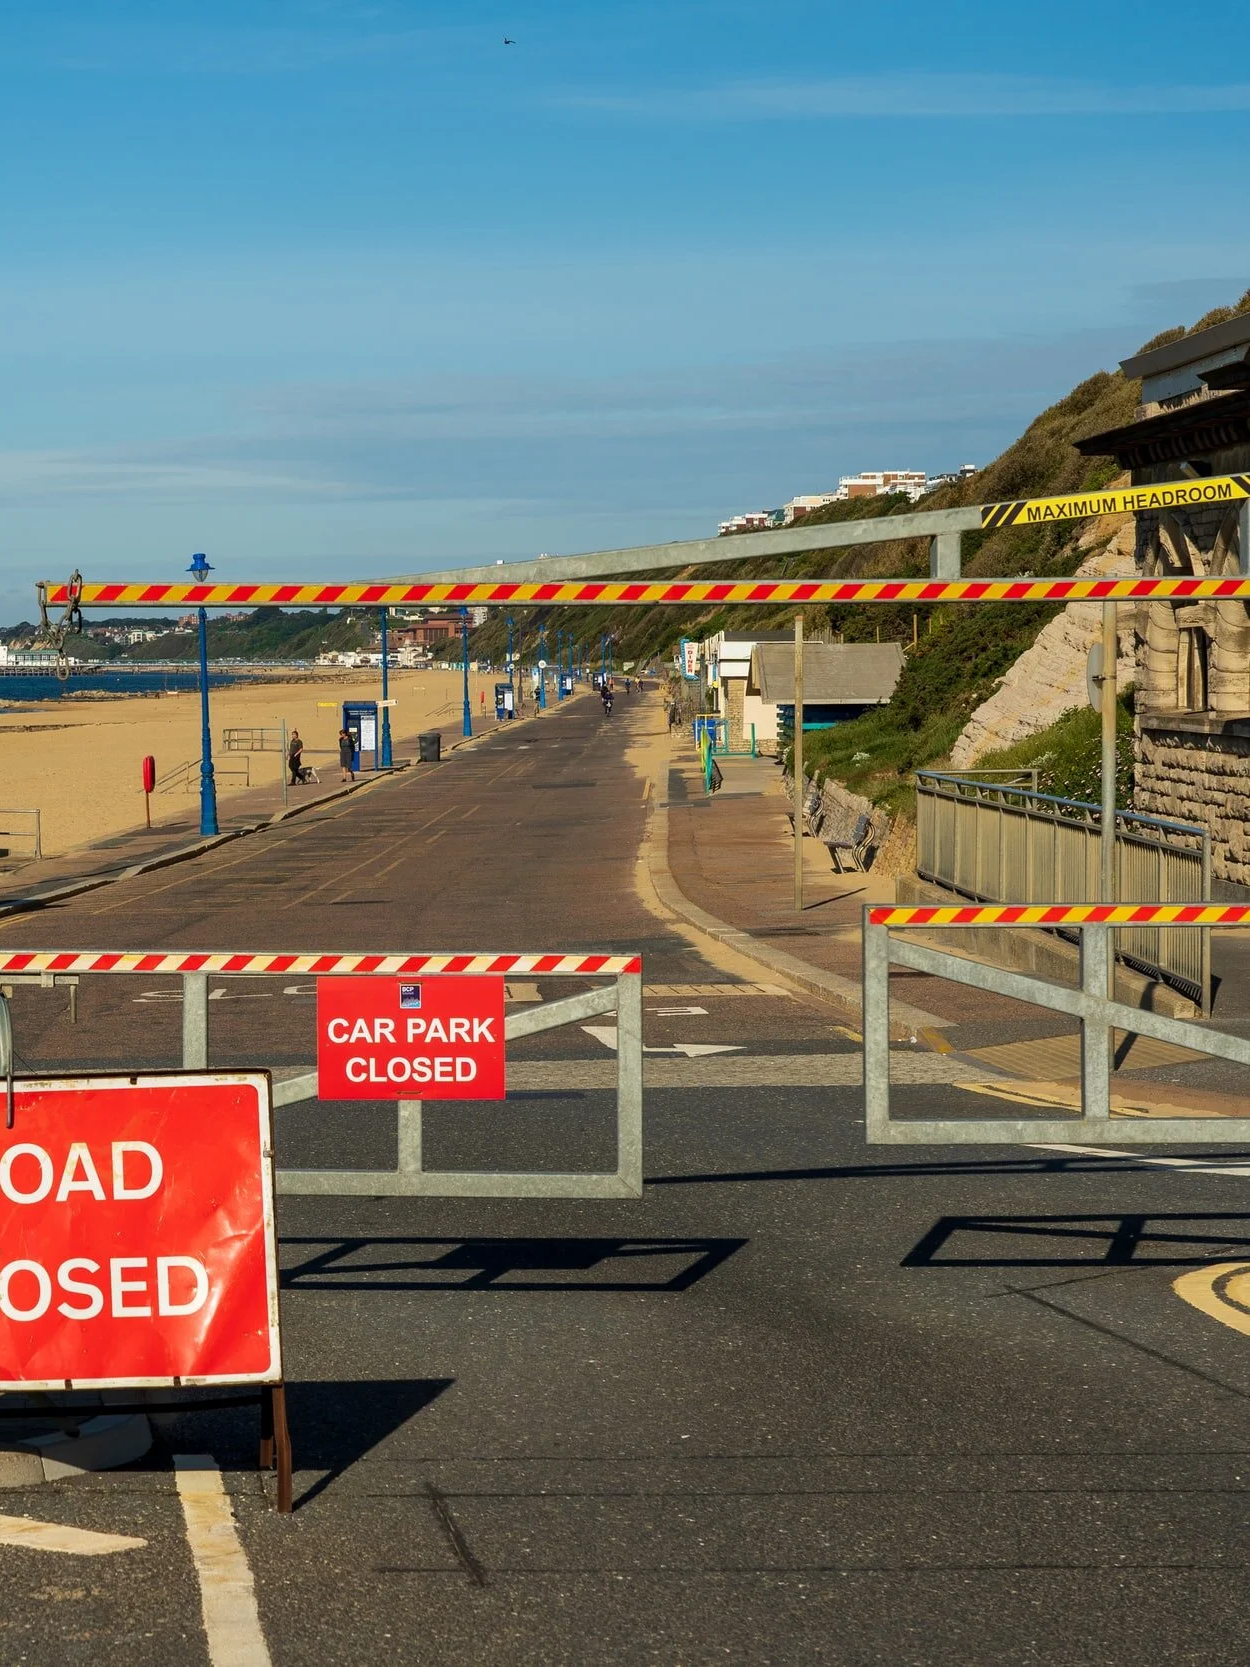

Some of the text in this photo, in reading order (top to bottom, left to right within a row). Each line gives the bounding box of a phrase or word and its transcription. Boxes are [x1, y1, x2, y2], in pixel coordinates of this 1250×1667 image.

[1026, 483, 1232, 522] MAXIMUM HEADROOM
[327, 1017, 496, 1044] CAR PARK
[345, 1056, 477, 1083] CLOSED
